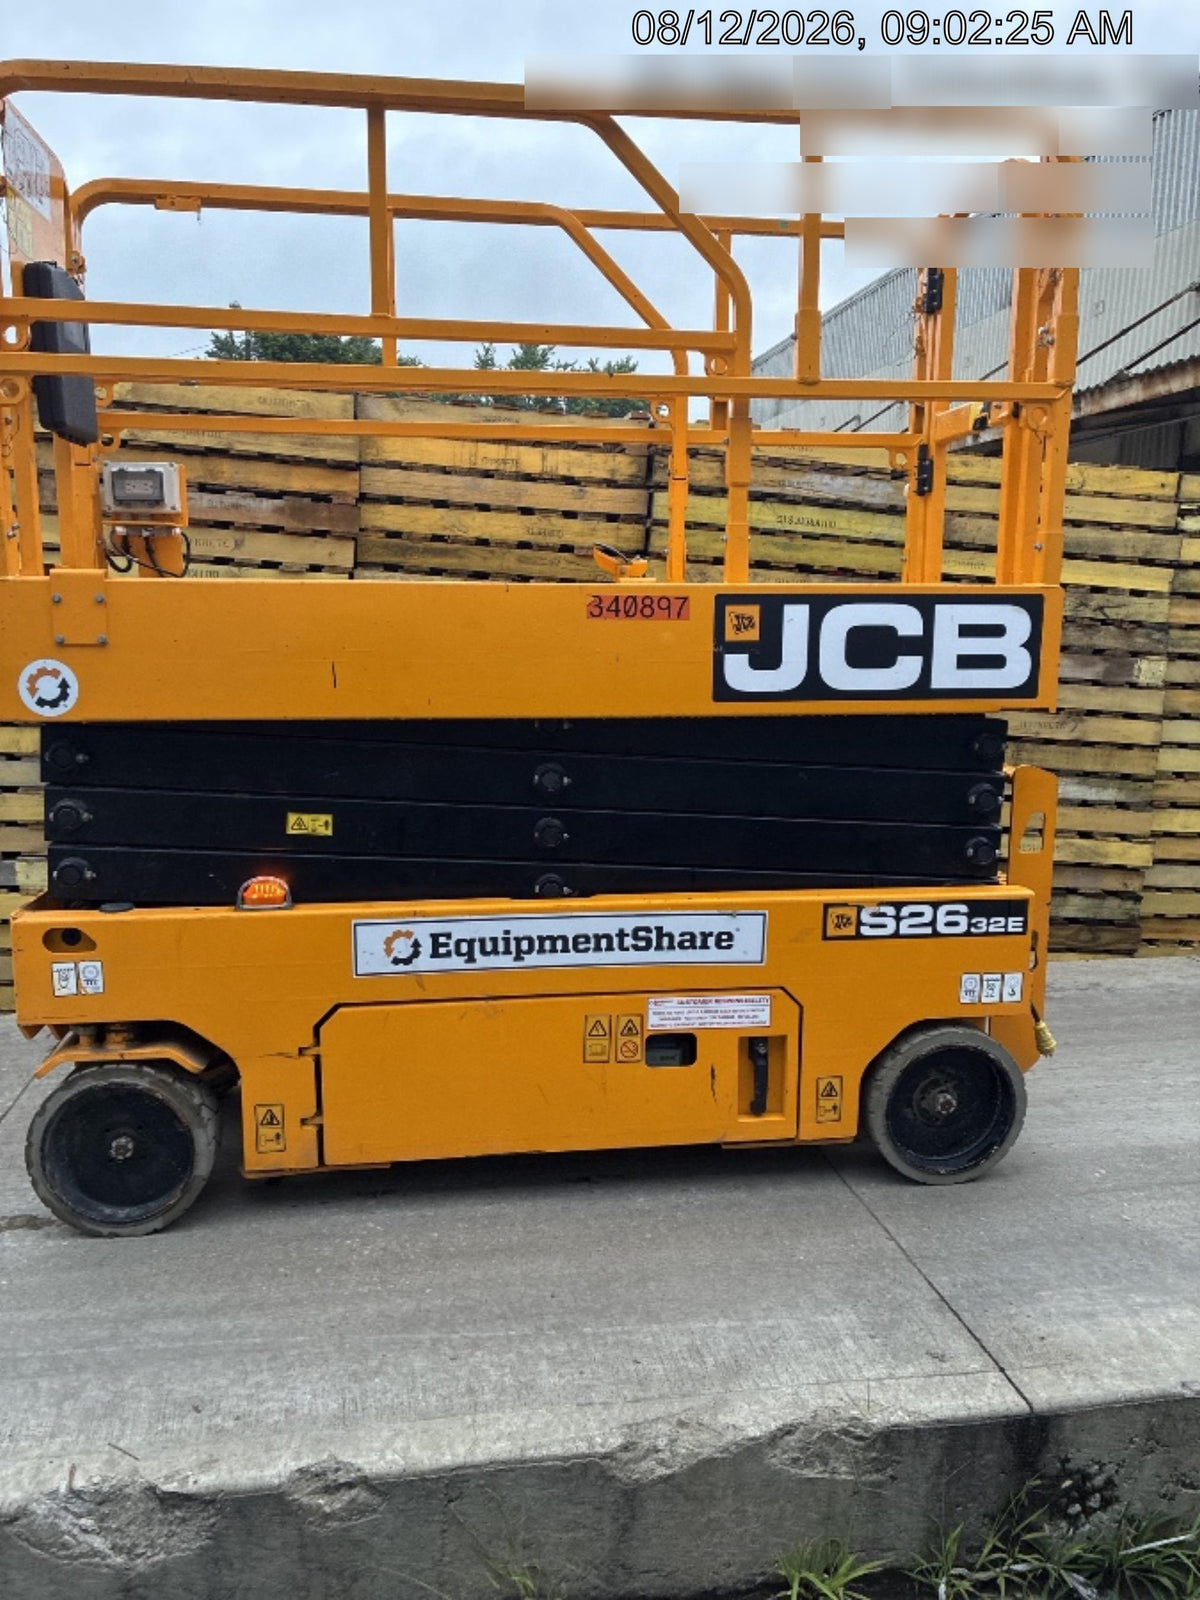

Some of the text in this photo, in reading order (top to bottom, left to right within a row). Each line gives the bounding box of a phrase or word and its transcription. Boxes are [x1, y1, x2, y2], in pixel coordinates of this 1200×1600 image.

[585, 592, 690, 619] 340897
[723, 603, 1032, 692] JCB
[428, 925, 735, 964] EquipmentShare
